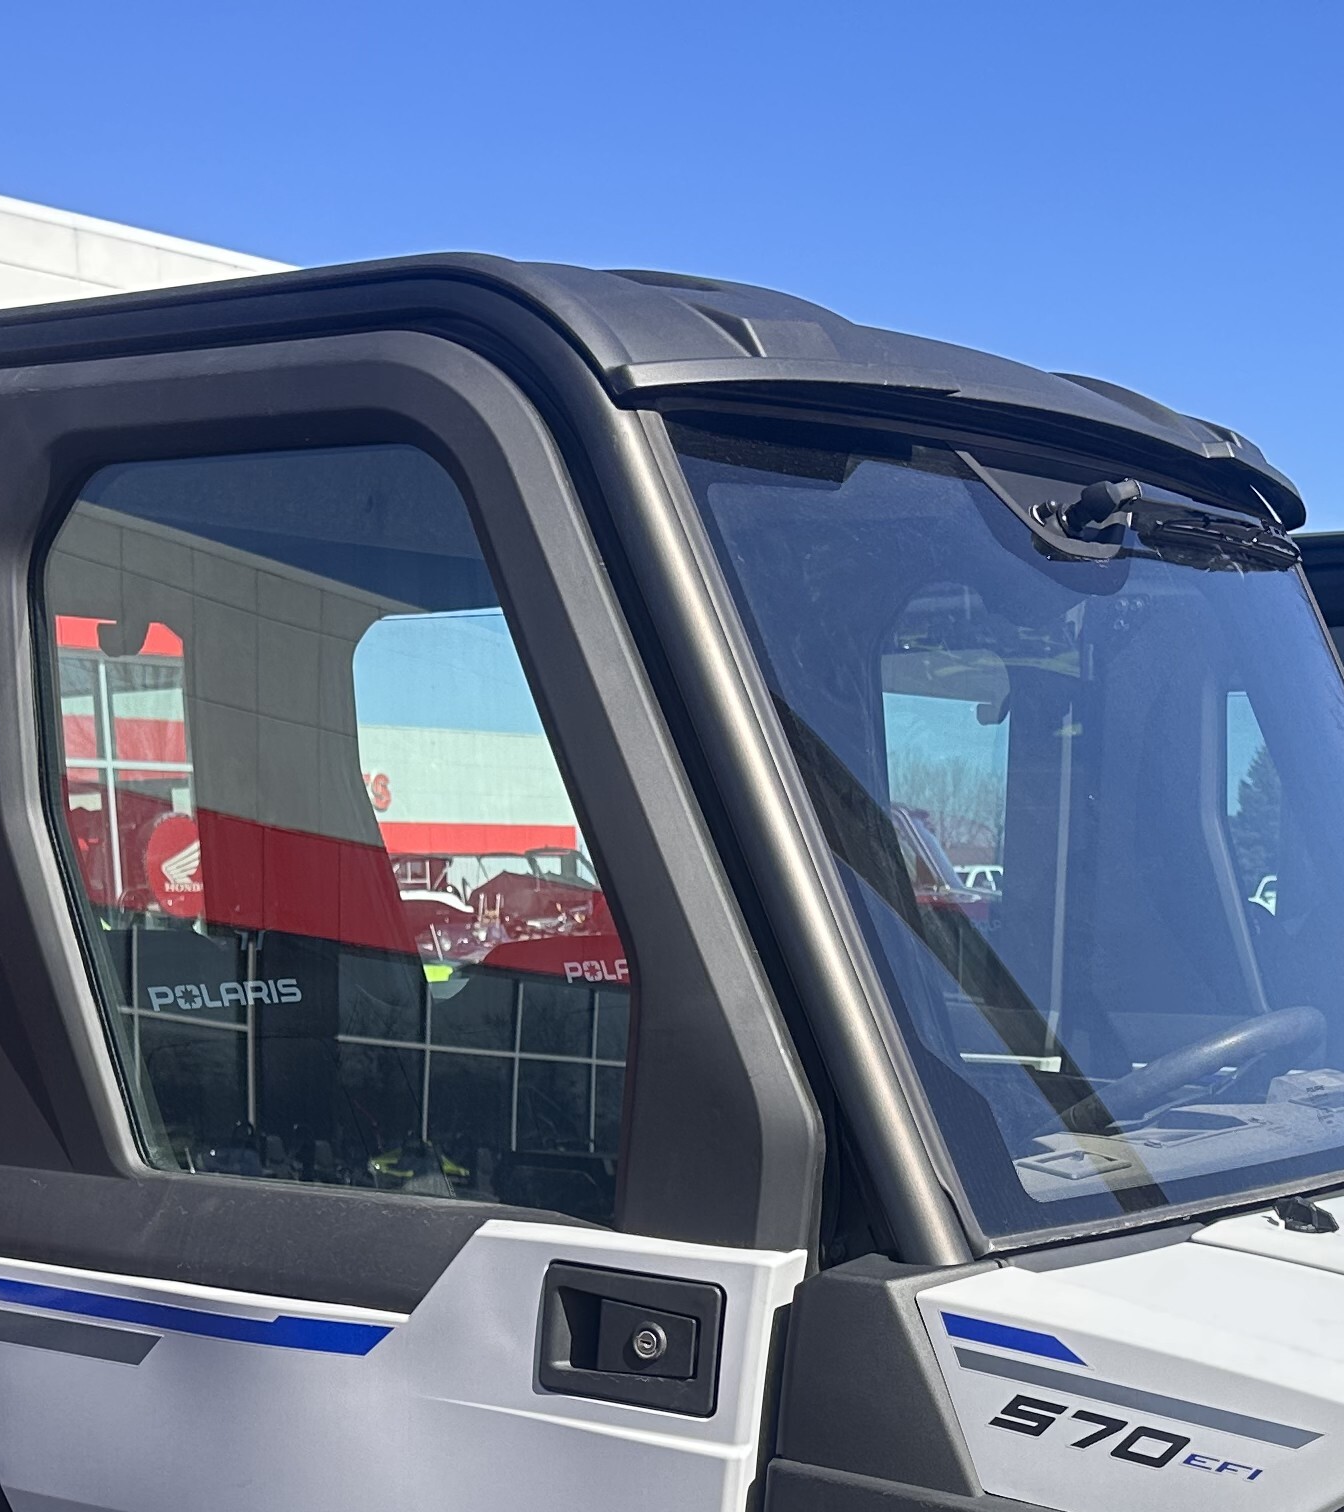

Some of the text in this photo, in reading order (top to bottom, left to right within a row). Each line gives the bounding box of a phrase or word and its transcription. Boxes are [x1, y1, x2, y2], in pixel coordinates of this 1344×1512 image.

[164, 882, 204, 893] HOND
[147, 978, 303, 1012] POLARIS
[988, 1394, 1263, 1480] 570 EFI
